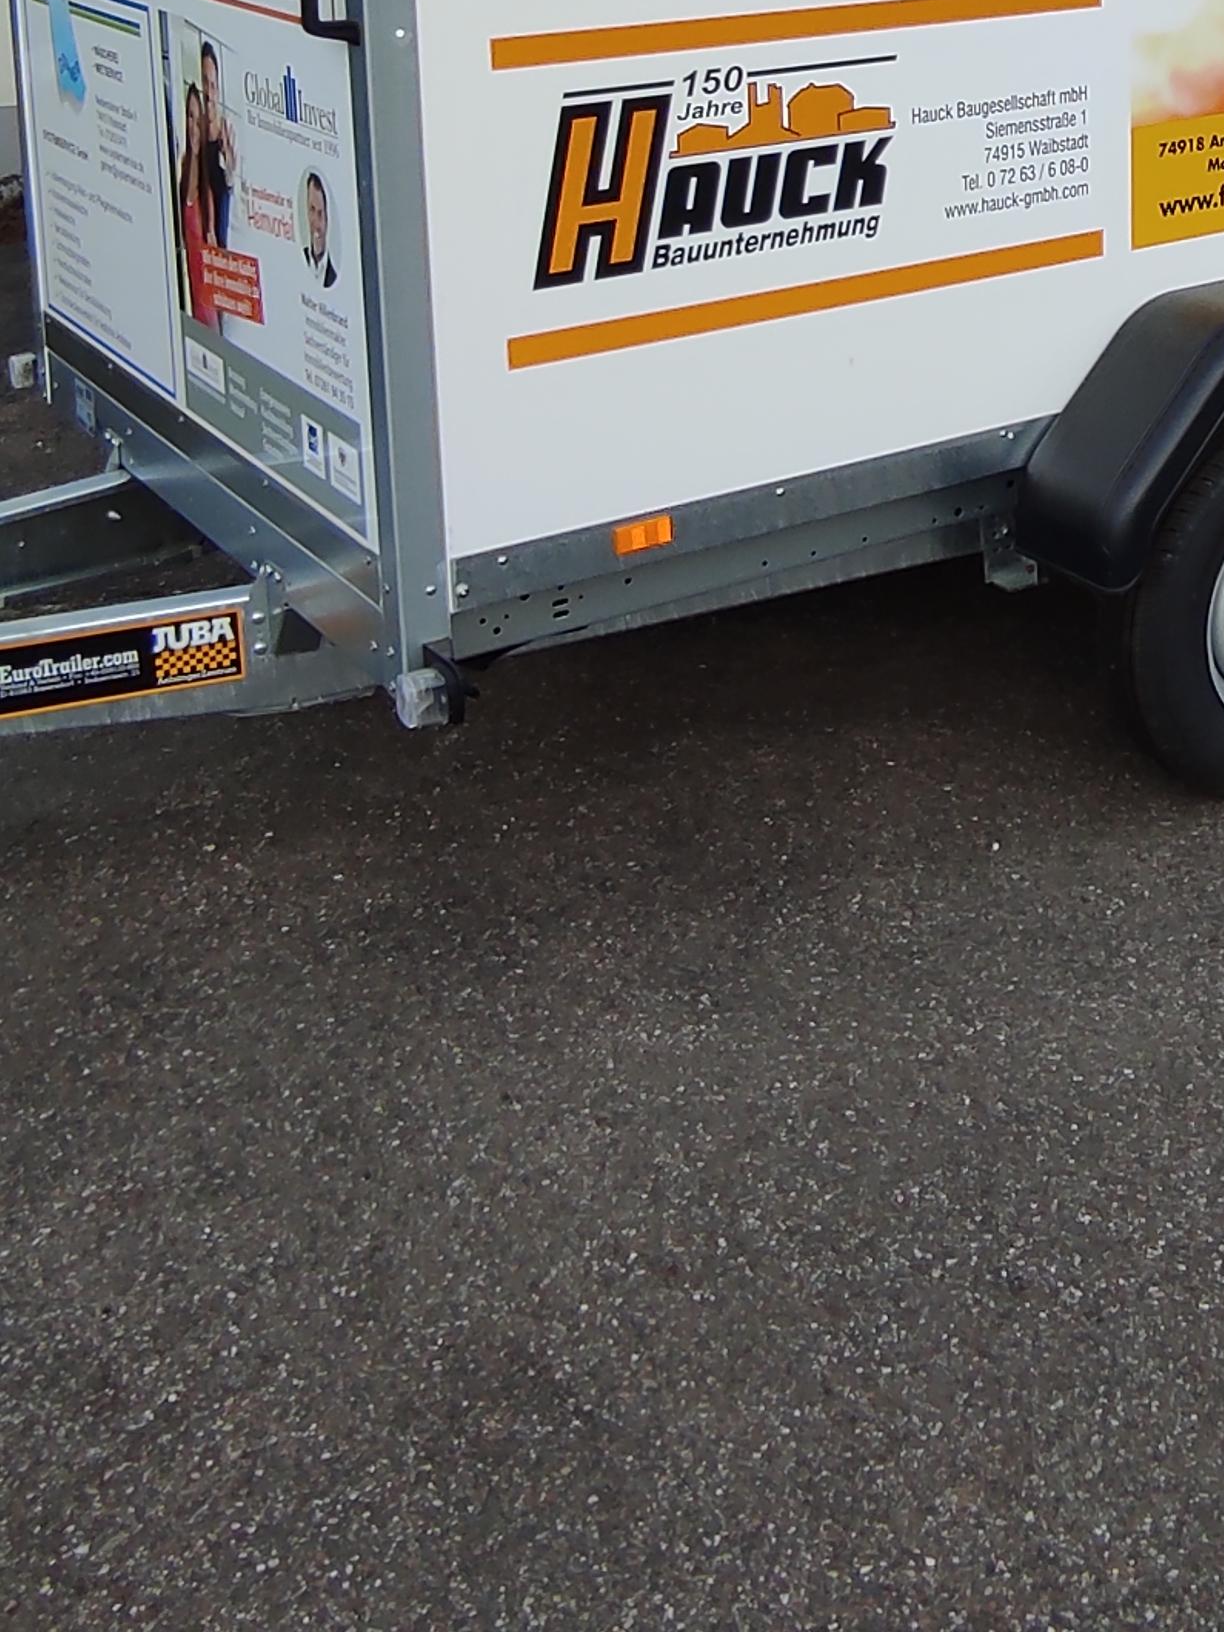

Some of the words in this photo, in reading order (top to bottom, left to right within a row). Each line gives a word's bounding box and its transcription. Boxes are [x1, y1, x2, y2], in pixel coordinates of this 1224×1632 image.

[682, 66, 745, 97] 150
[244, 71, 284, 115] Global
[298, 89, 337, 135] Invest
[677, 99, 744, 122] Jahre
[912, 104, 953, 124] Hauck
[957, 90, 1055, 119] Baugesellschaft
[1060, 85, 1087, 103] mbH
[986, 112, 1076, 139] Siemensstraße
[1081, 110, 1086, 124] 1
[984, 142, 1025, 163] 74915
[1028, 134, 1089, 156] Waibstadt
[1159, 136, 1204, 158] 74918
[962, 174, 982, 191] Tel.
[987, 171, 995, 187] 0
[1000, 168, 1016, 185] 72
[1020, 164, 1036, 182] 63
[1048, 162, 1056, 177] 6
[1060, 157, 1088, 175] 08-0
[532, 93, 893, 291] HAUCK
[944, 183, 1089, 218] www.hauck-gmbh.com
[651, 215, 880, 270] Bauunternehmung
[152, 617, 235, 653] JUBA
